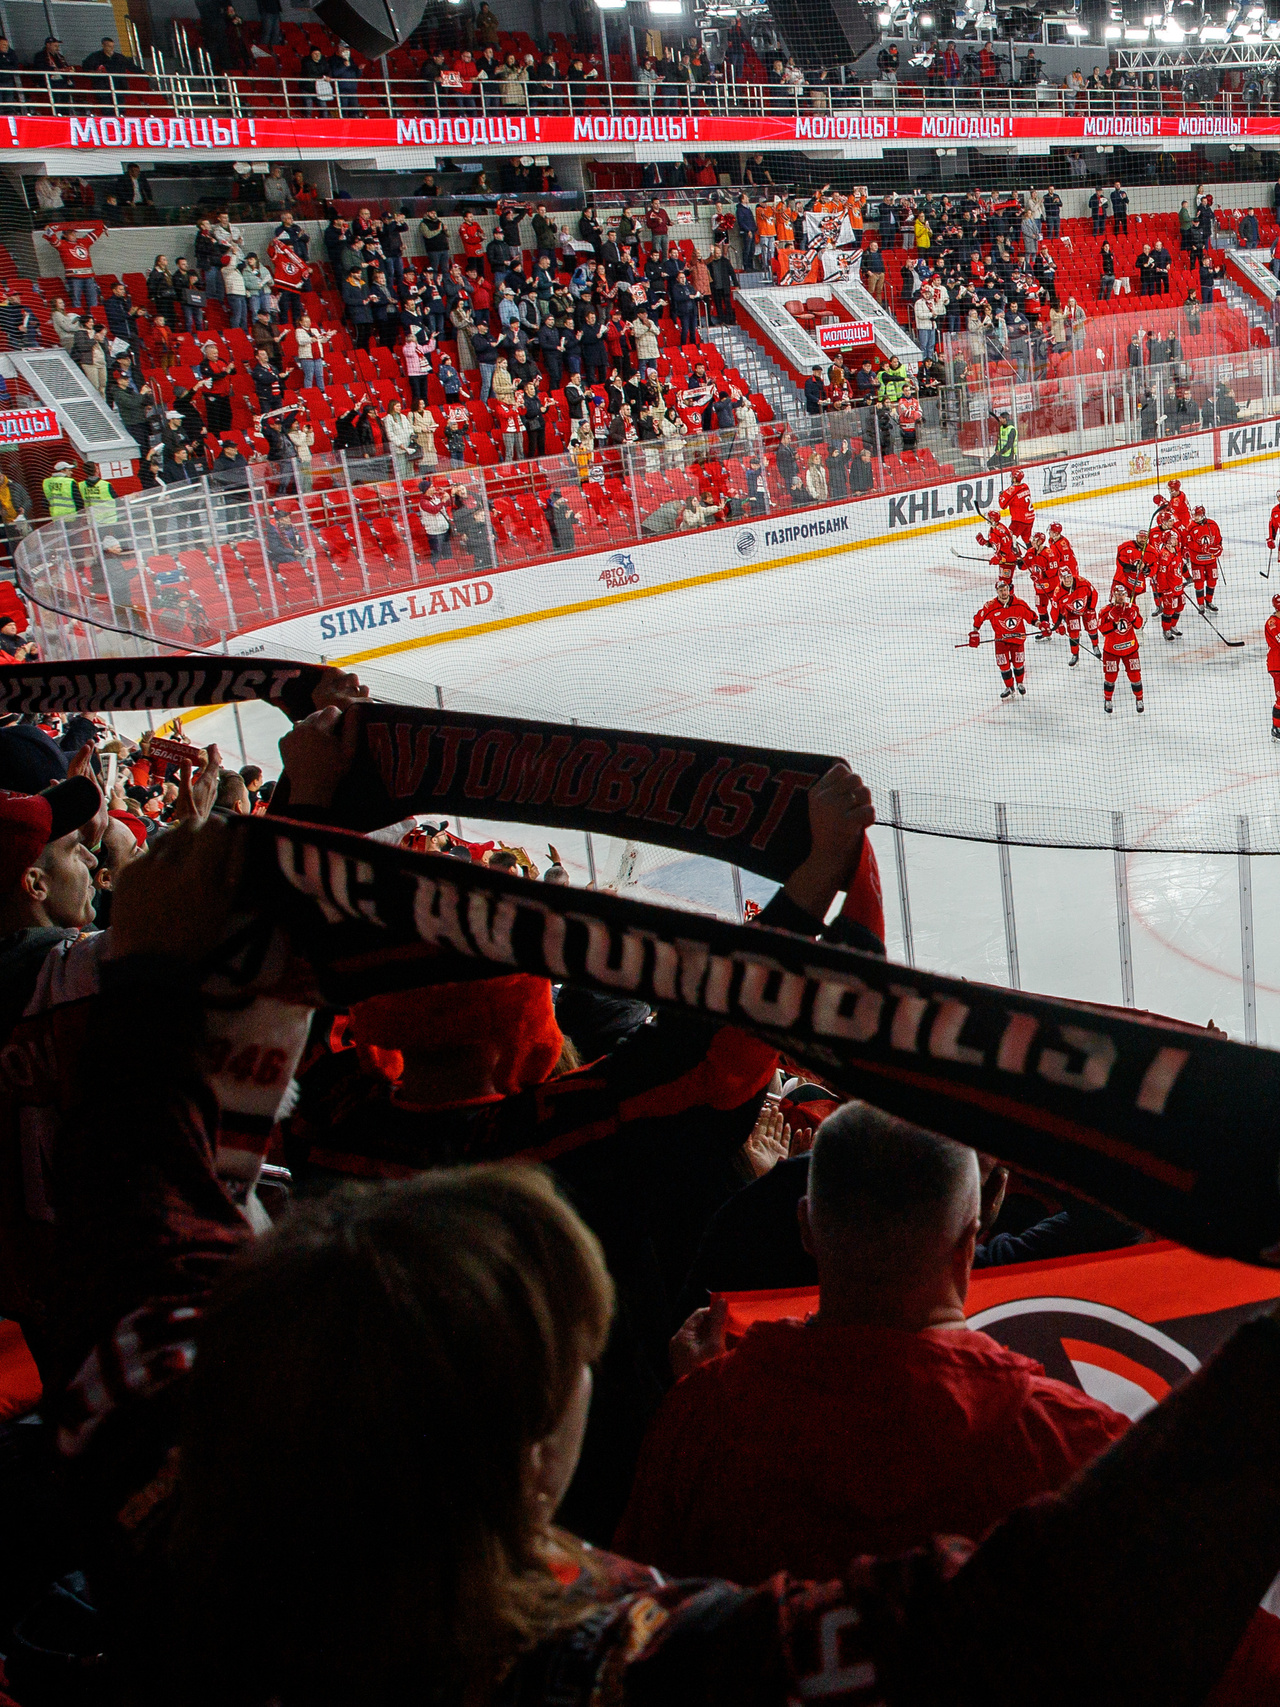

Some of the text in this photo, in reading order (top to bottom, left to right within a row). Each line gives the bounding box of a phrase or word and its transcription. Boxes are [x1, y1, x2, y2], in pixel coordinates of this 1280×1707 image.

[823, 326, 870, 342] МОЛОДЦЫ
[888, 478, 995, 529] KHL.RU
[765, 516, 849, 547] ГАЗПРОМБАНК
[598, 566, 625, 582] АВТО
[606, 573, 640, 589] РАДИО
[320, 580, 494, 640] SIMA-LAND
